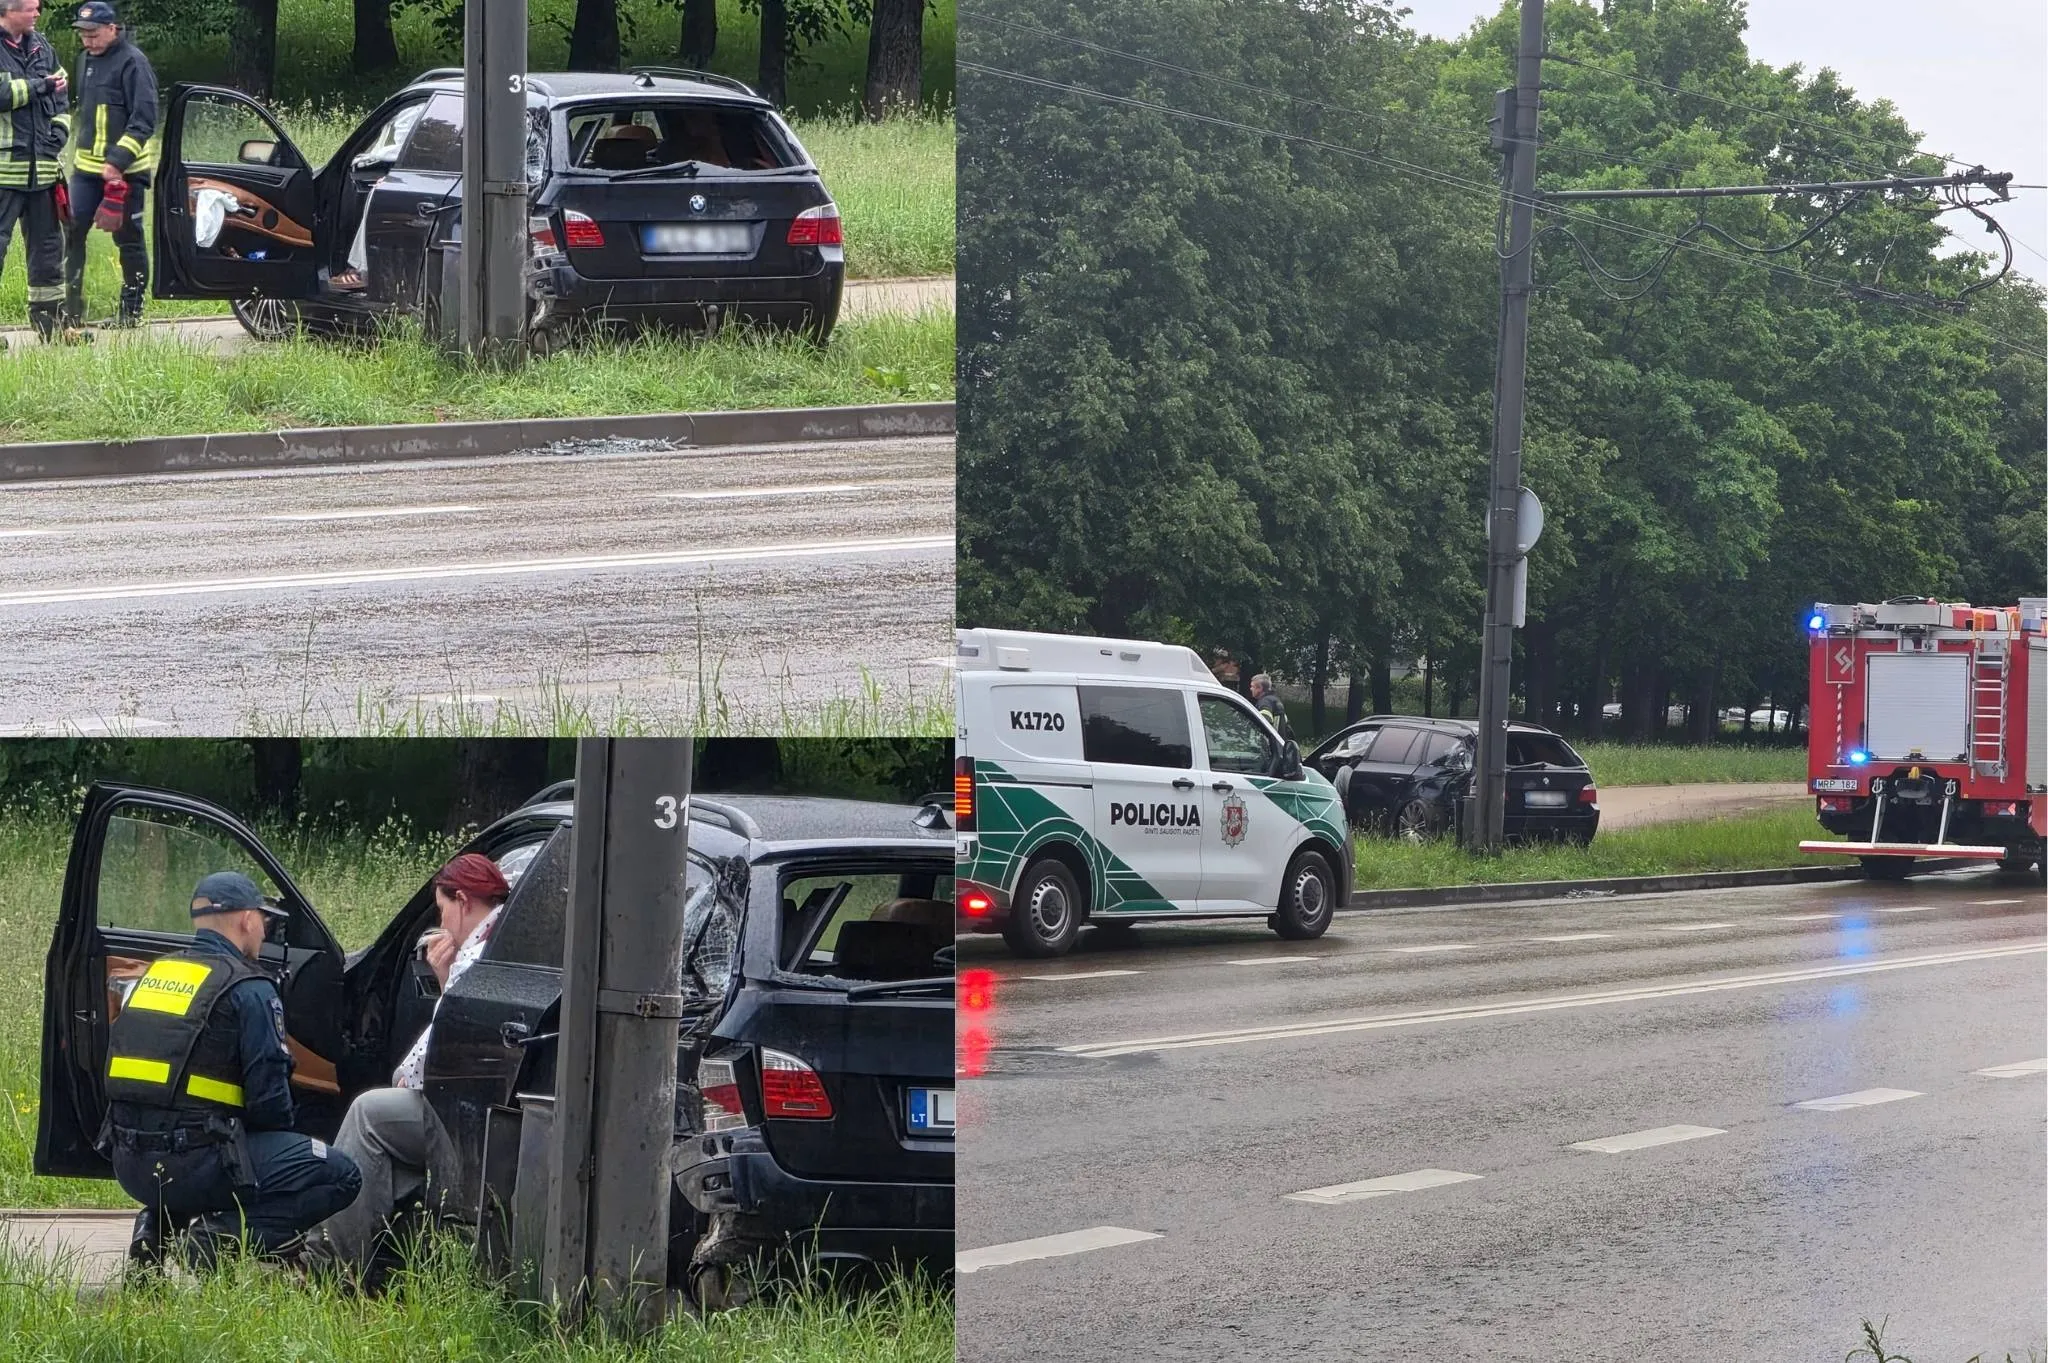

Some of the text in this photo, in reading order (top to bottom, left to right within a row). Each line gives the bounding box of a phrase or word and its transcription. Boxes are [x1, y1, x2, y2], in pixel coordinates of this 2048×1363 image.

[1010, 710, 1065, 732] K1720
[1818, 780, 1856, 789] MRP 182
[654, 793, 689, 829] 31
[1110, 802, 1201, 826] POLICIJA
[140, 976, 195, 995] POLICIJA
[911, 1113, 926, 1123] LT
